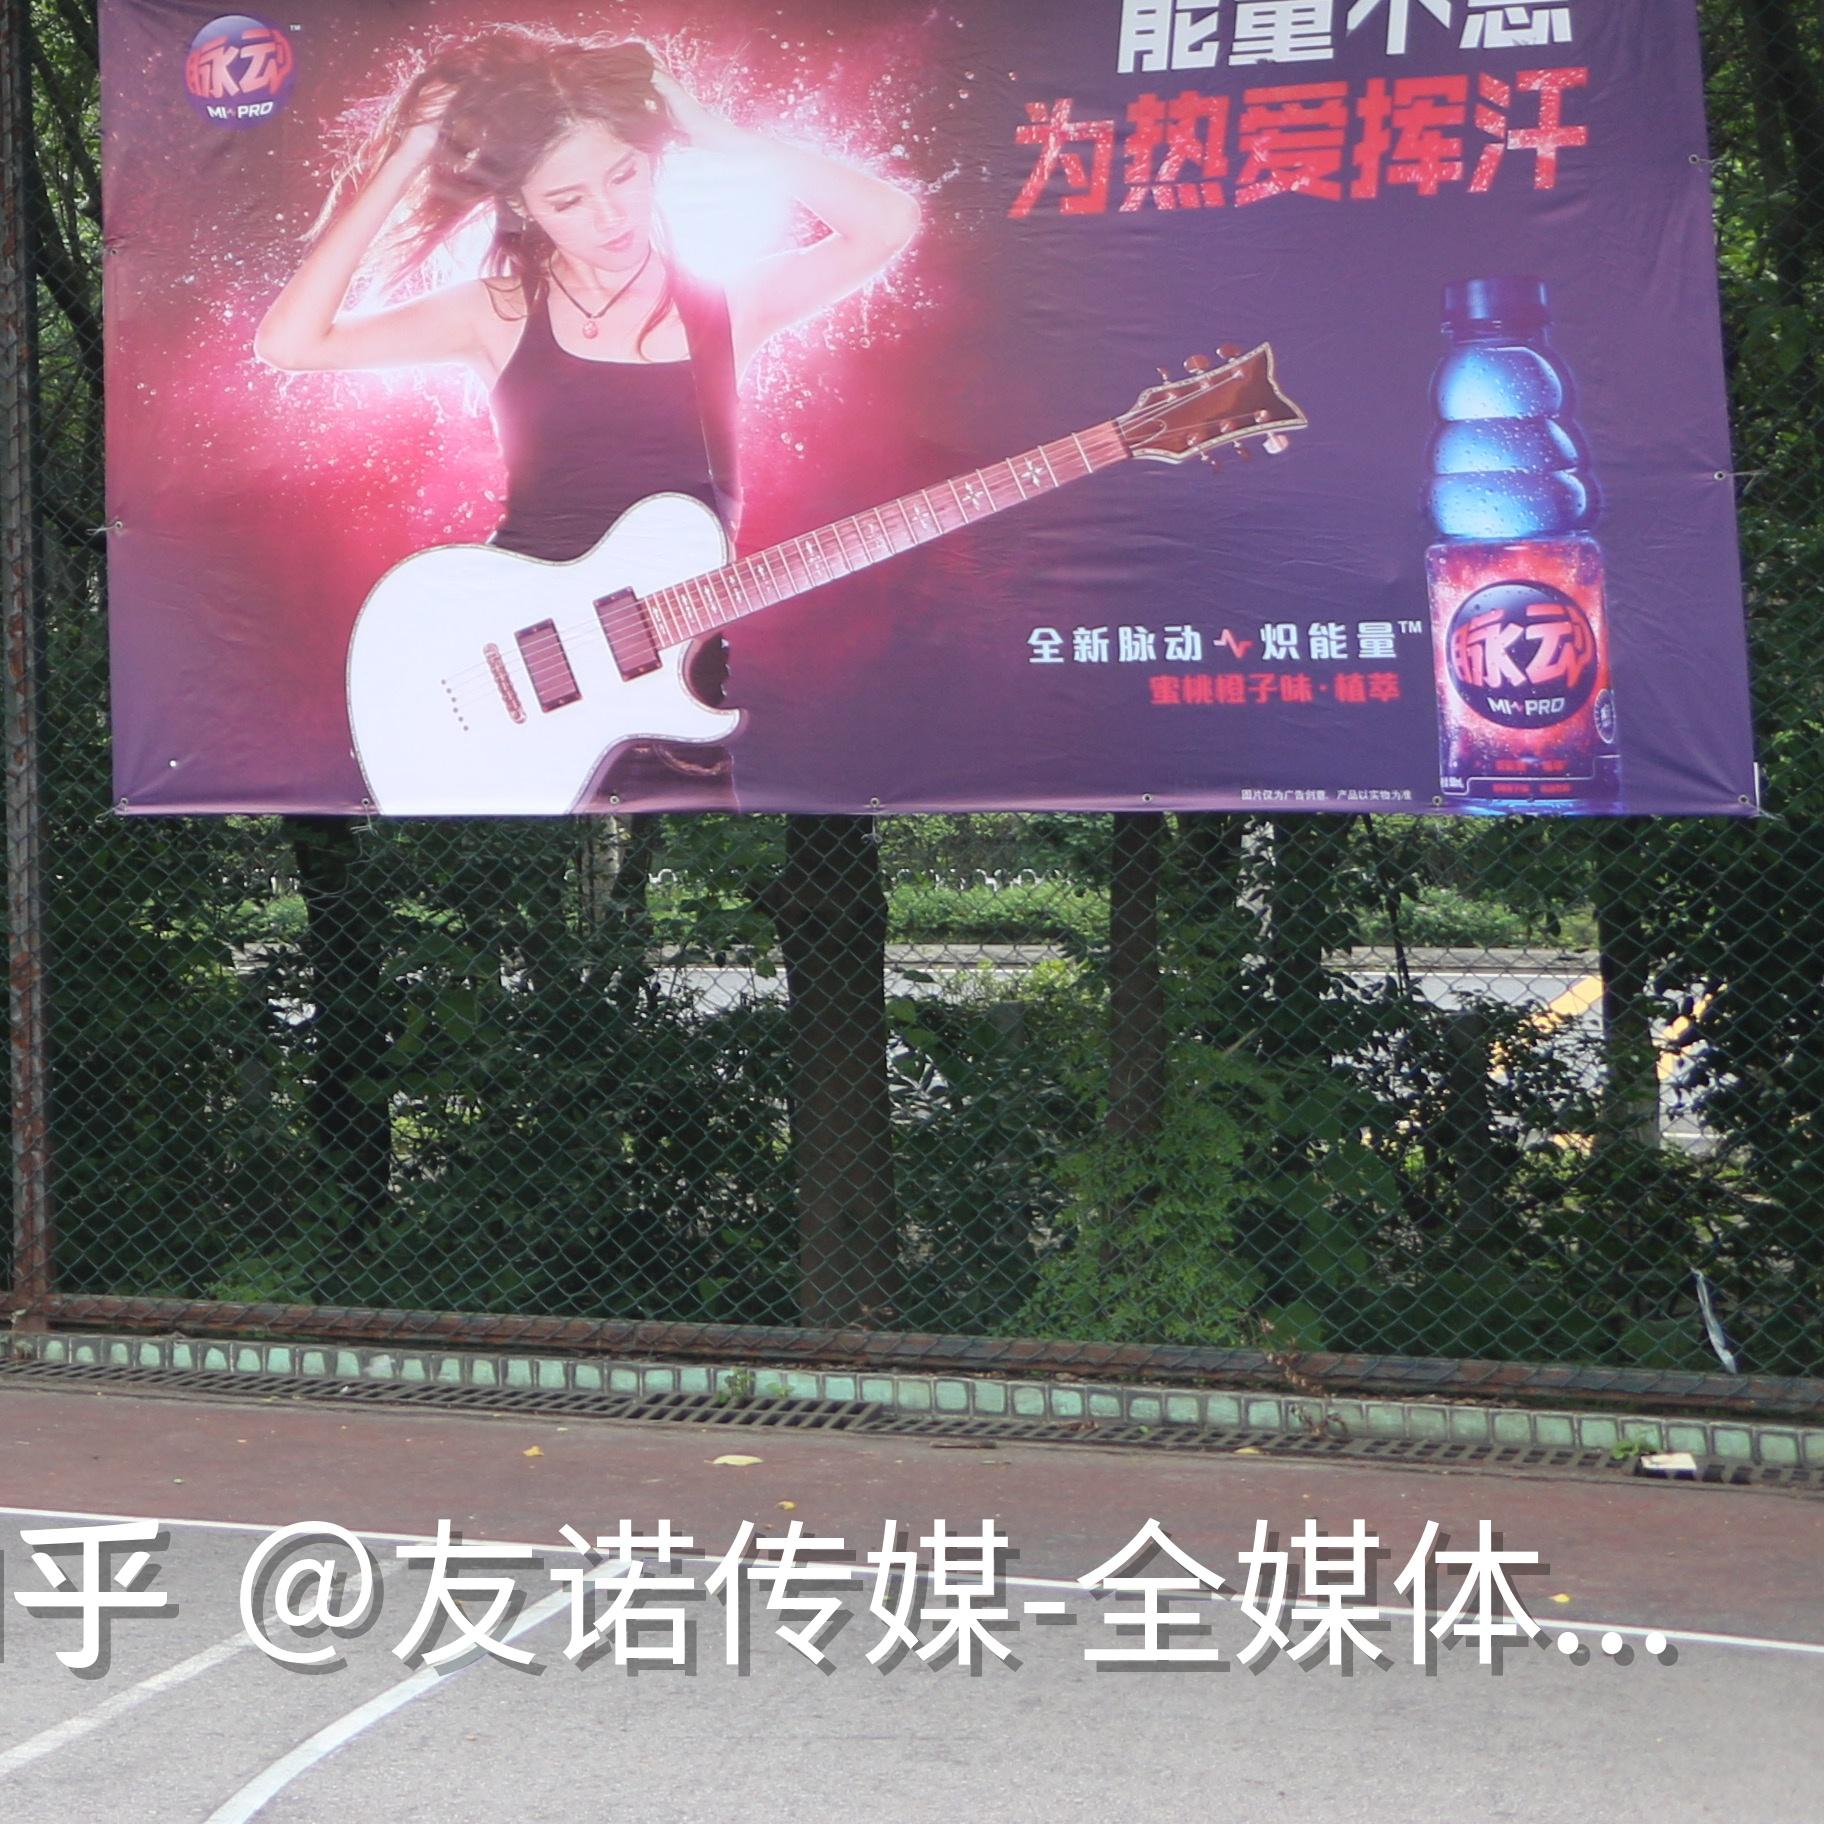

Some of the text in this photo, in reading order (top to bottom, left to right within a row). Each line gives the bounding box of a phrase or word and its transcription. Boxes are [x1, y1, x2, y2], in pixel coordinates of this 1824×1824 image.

[1006, 67, 1588, 218] 为热爱挥汗
